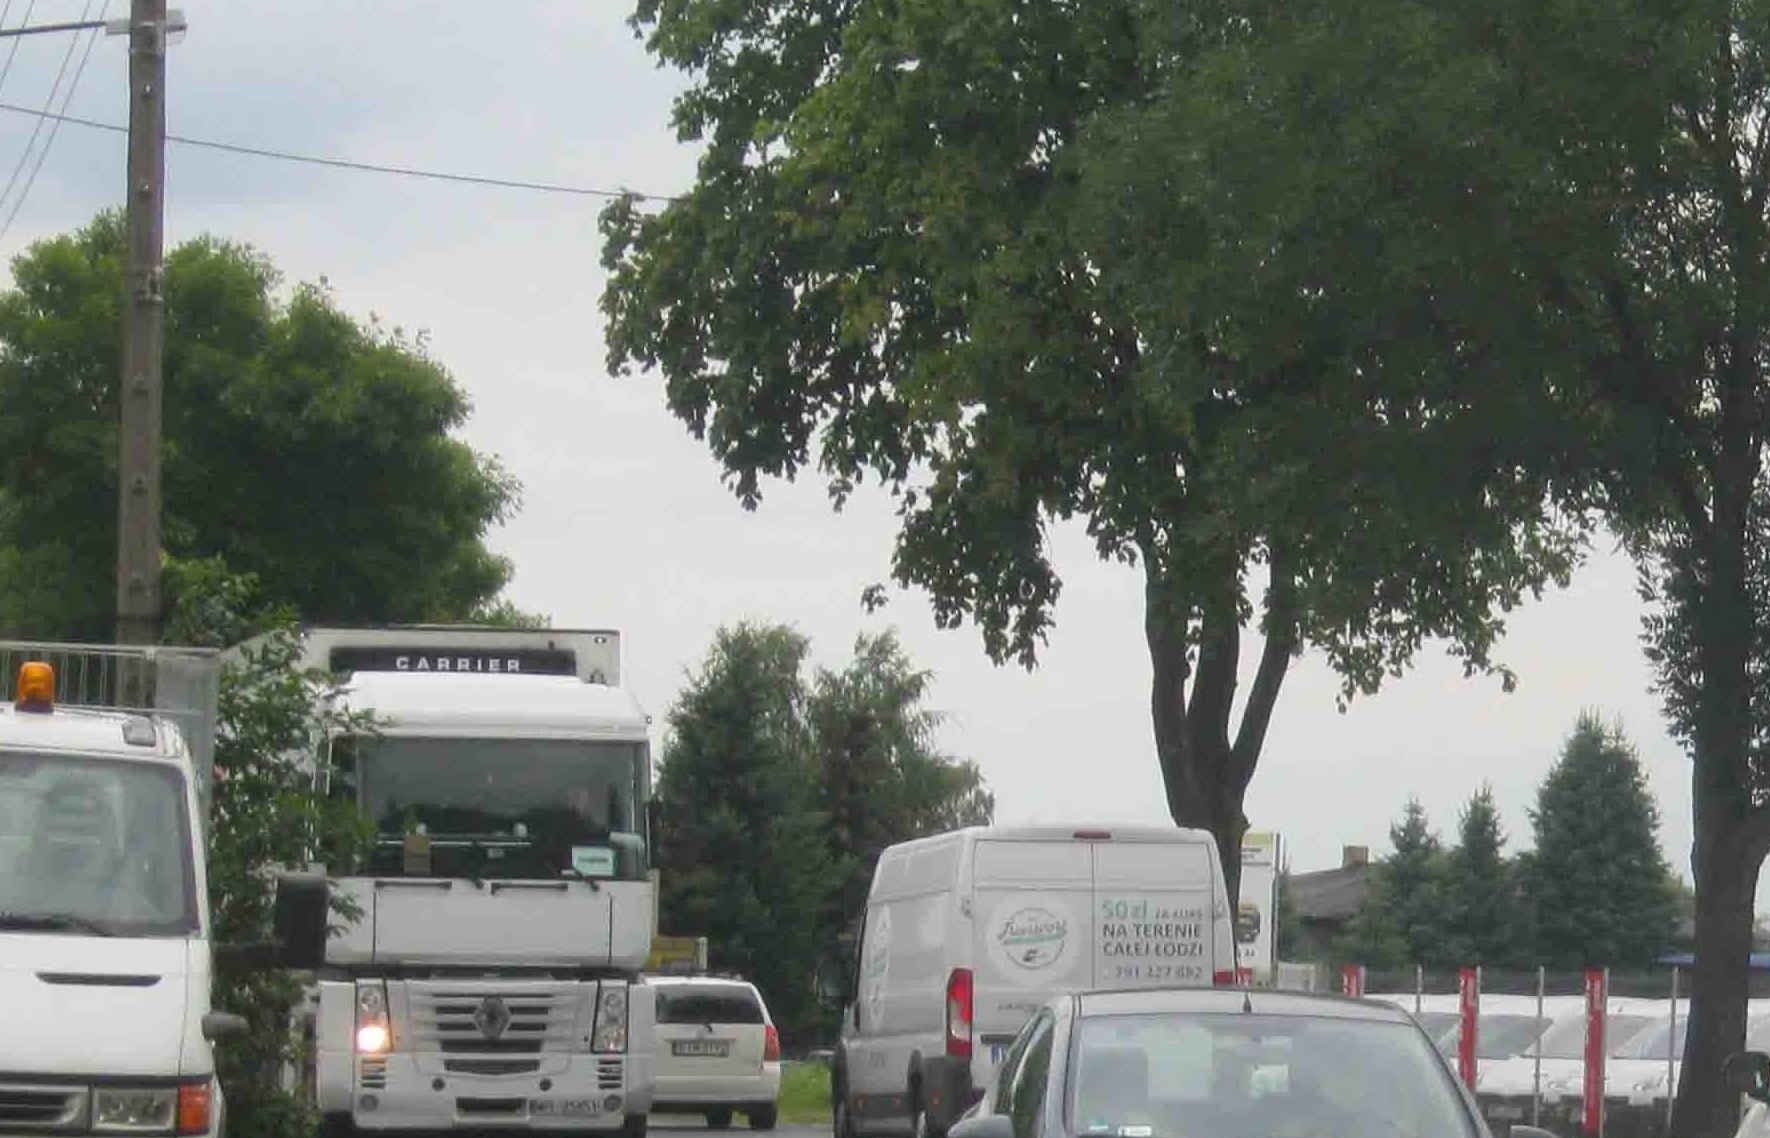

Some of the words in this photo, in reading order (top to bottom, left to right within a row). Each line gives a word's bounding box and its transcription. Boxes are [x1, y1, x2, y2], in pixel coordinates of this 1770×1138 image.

[395, 655, 521, 673] CARRIER
[1102, 923, 1128, 938] NA
[1132, 923, 1202, 938] TERENIE
